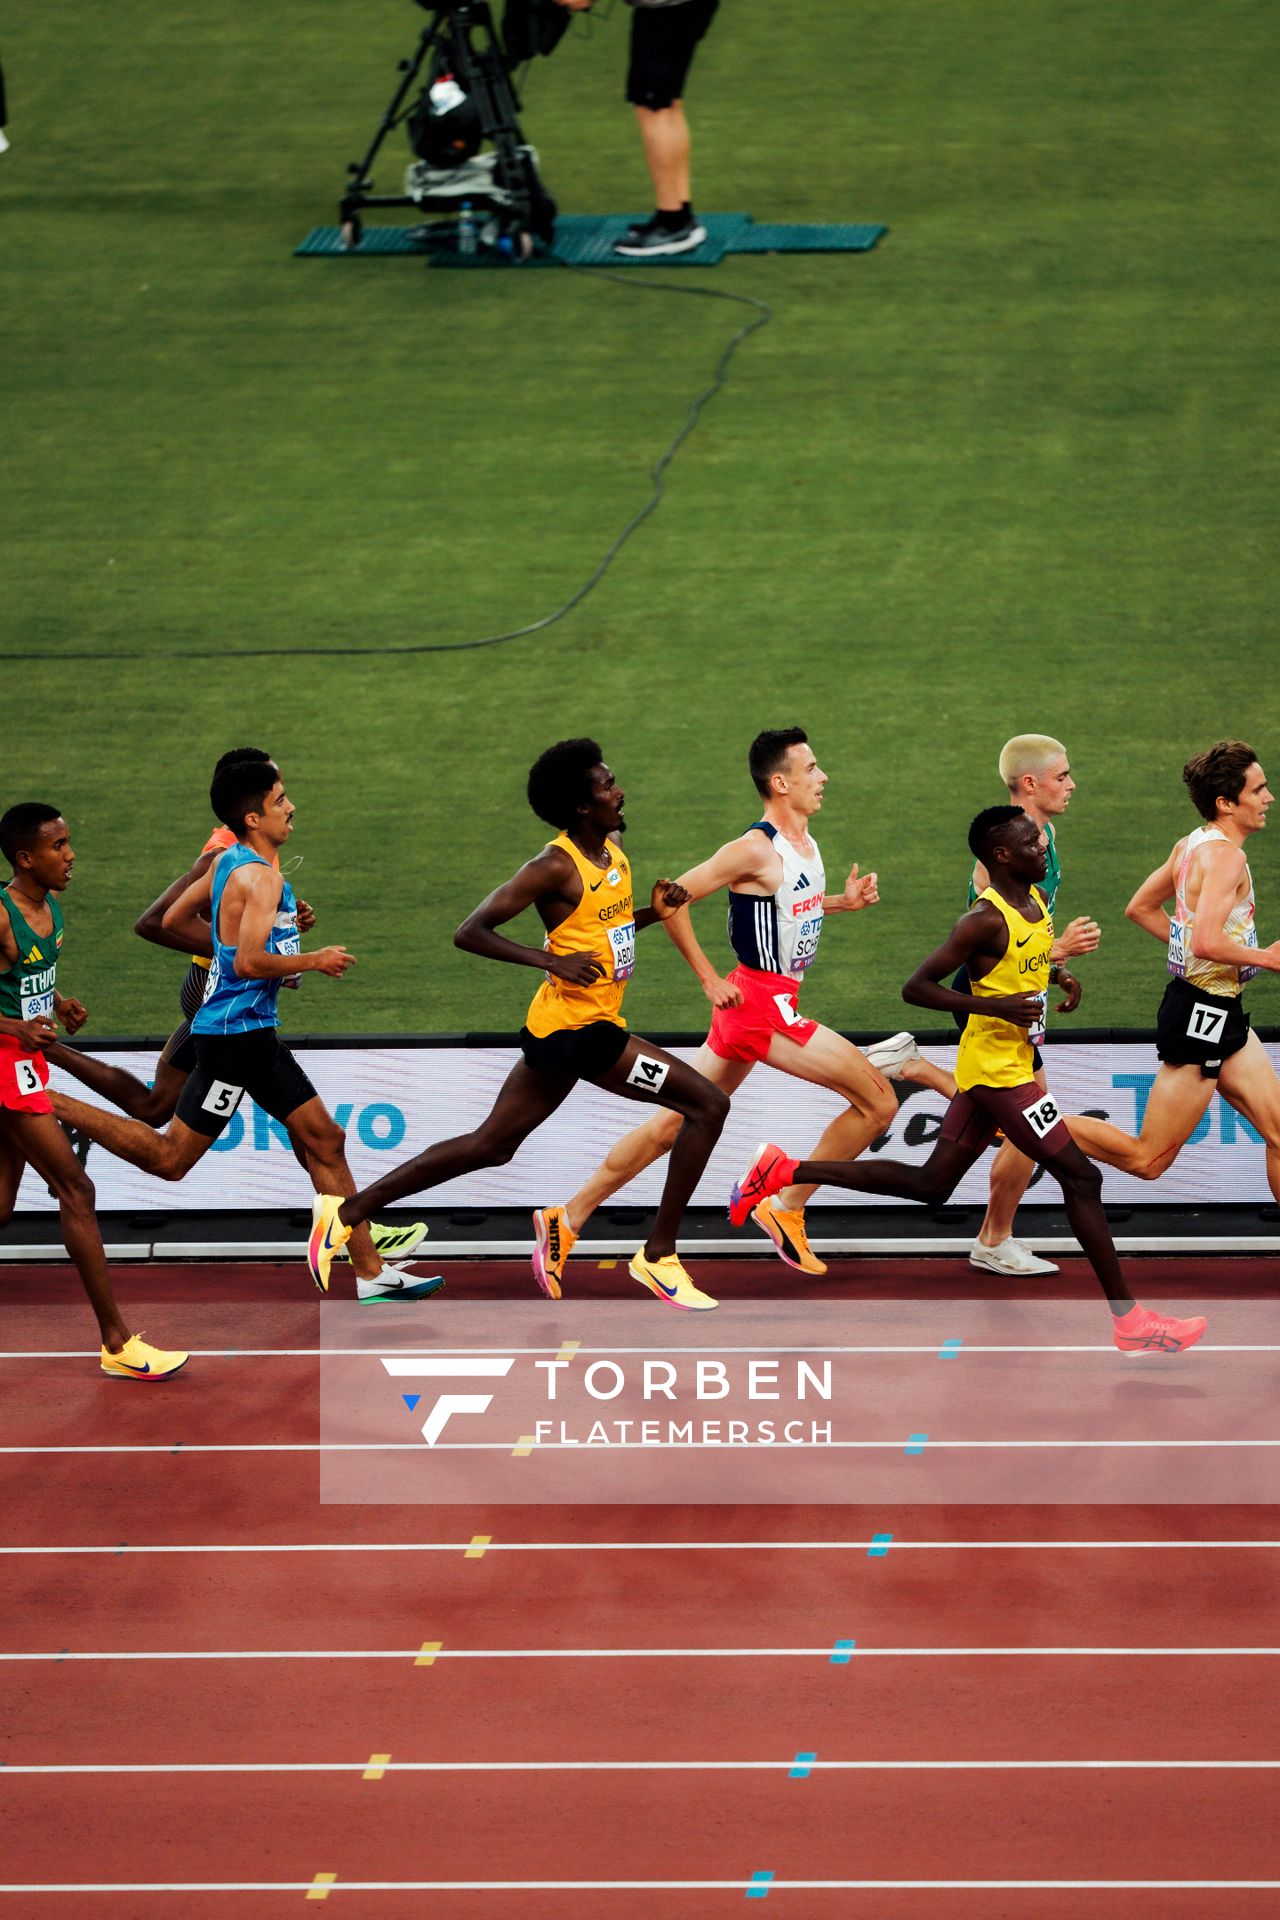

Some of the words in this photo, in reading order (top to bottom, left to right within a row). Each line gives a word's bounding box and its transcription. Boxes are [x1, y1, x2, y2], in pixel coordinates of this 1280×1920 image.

[1170, 922, 1183, 943] DK
[1194, 1009, 1223, 1037] 17
[23, 1065, 37, 1089] 3
[633, 1061, 664, 1088] 14
[214, 1088, 234, 1112] 5
[1028, 1101, 1058, 1131] 18
